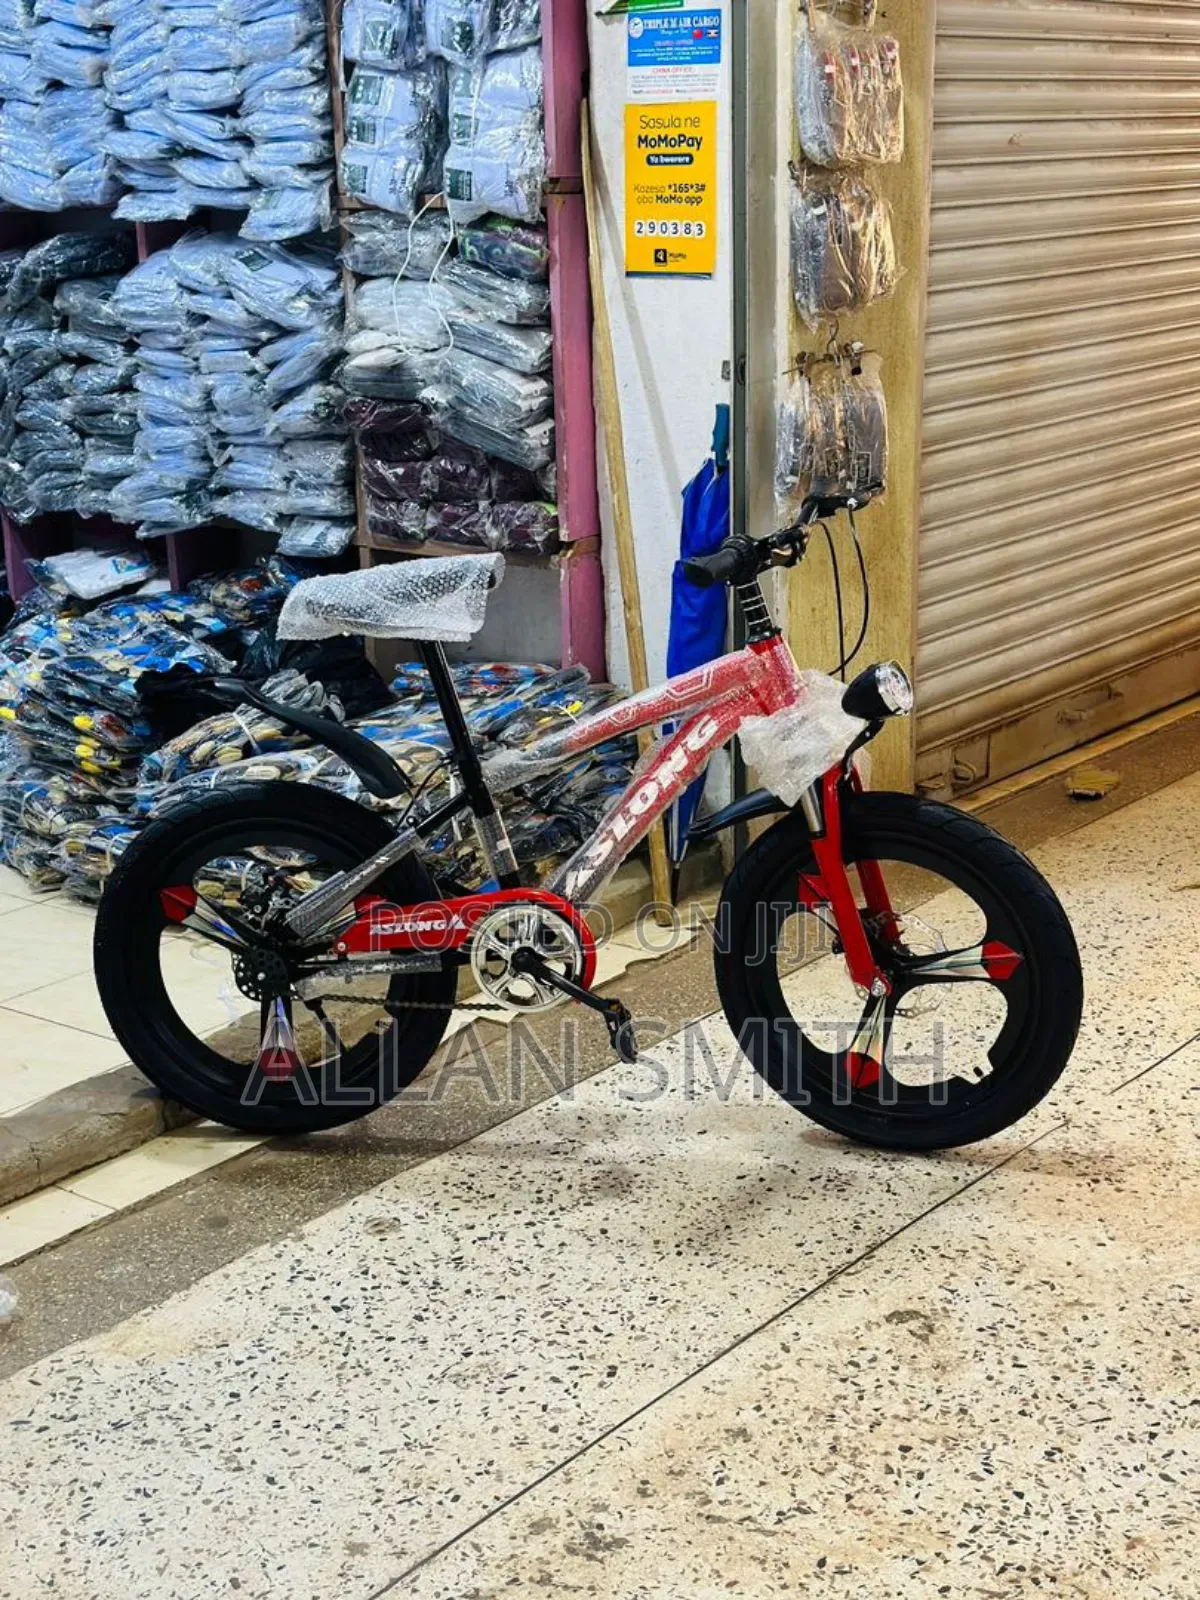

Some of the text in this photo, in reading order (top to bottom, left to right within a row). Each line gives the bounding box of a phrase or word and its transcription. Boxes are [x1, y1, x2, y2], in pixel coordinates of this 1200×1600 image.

[693, 15, 720, 27] CARGO
[639, 114, 701, 129] Sasula ne
[638, 134, 703, 151] MoMoPay
[656, 195, 684, 204] MoMo
[685, 196, 703, 206] app
[636, 221, 704, 236] 290383
